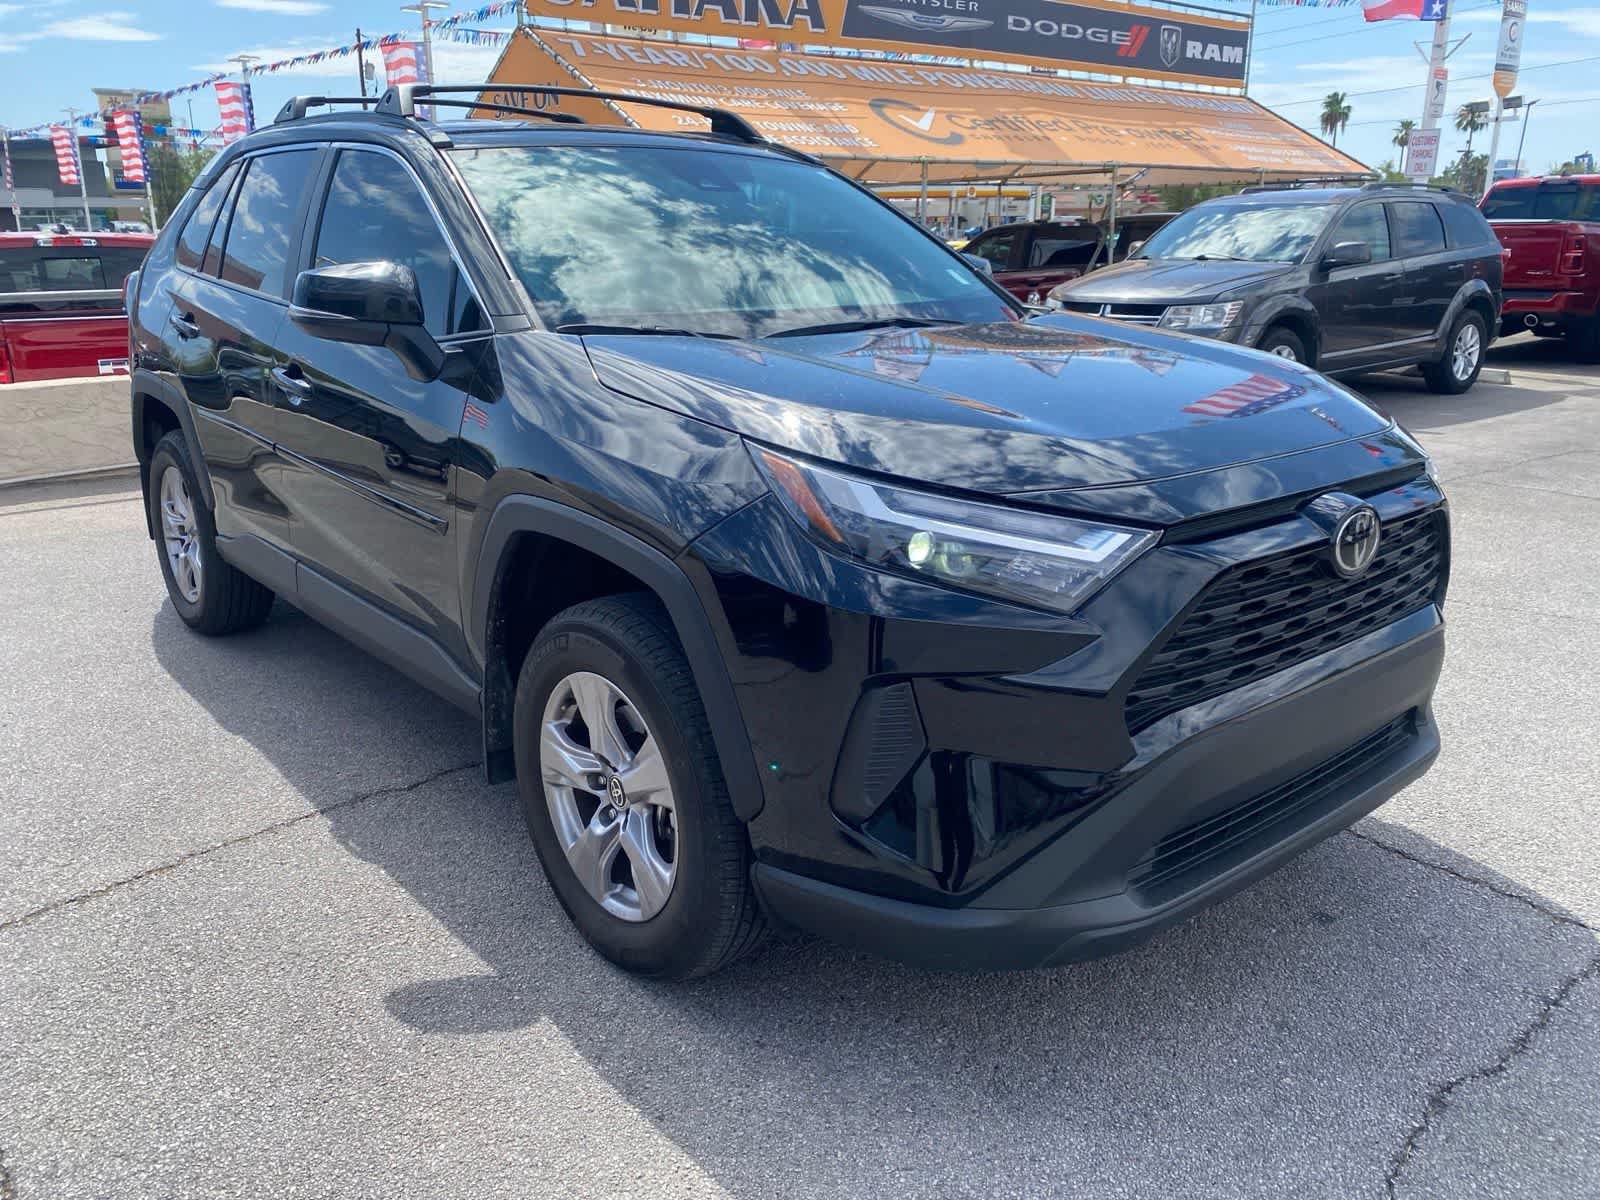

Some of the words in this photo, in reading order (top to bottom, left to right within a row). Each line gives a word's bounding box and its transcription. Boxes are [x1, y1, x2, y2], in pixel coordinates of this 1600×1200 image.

[1007, 15, 1131, 46] DODGE
[1186, 40, 1243, 64] RAM
[534, 80, 560, 109] ON
[843, 63, 923, 86] MILE
[917, 70, 1078, 97] POWERTRAIN
